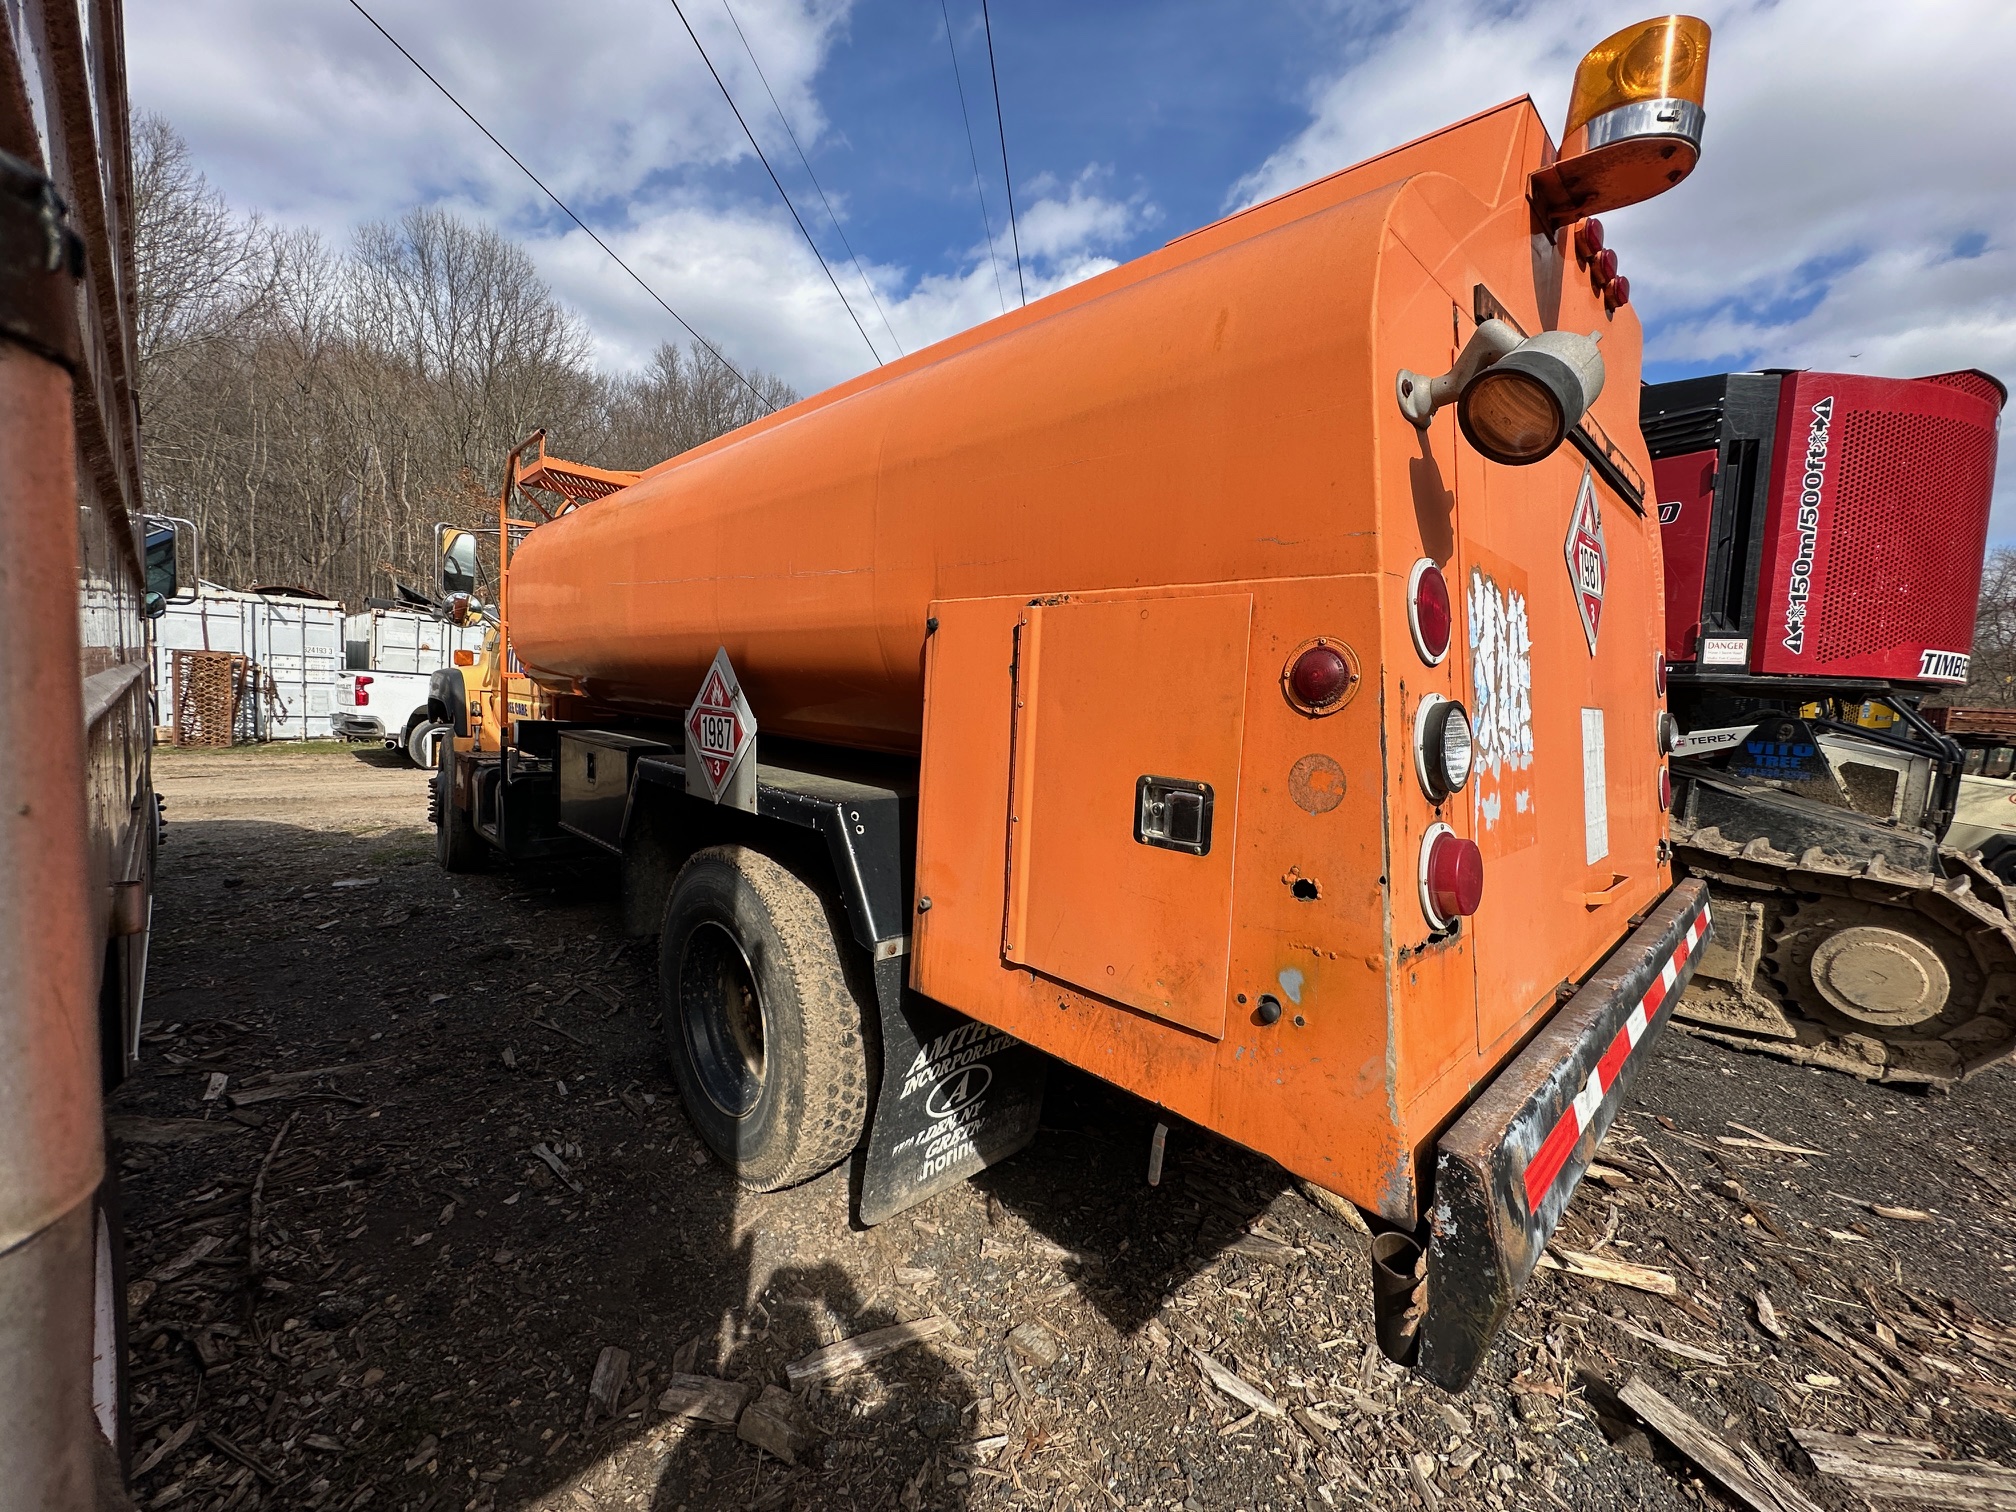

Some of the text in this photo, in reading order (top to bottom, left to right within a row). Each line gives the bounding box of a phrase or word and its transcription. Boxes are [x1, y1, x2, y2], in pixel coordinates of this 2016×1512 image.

[1789, 447, 1828, 606] 150m/500ft
[1580, 545, 1600, 591] 1987
[1590, 603, 1596, 624] 3
[1707, 641, 1744, 650] DANGER
[703, 717, 731, 750] 1987
[1688, 732, 1738, 746] TEREX
[1746, 741, 1815, 757] VITO
[714, 760, 720, 776] 3
[1753, 754, 1802, 769] TREE
[940, 1070, 971, 1111] A
